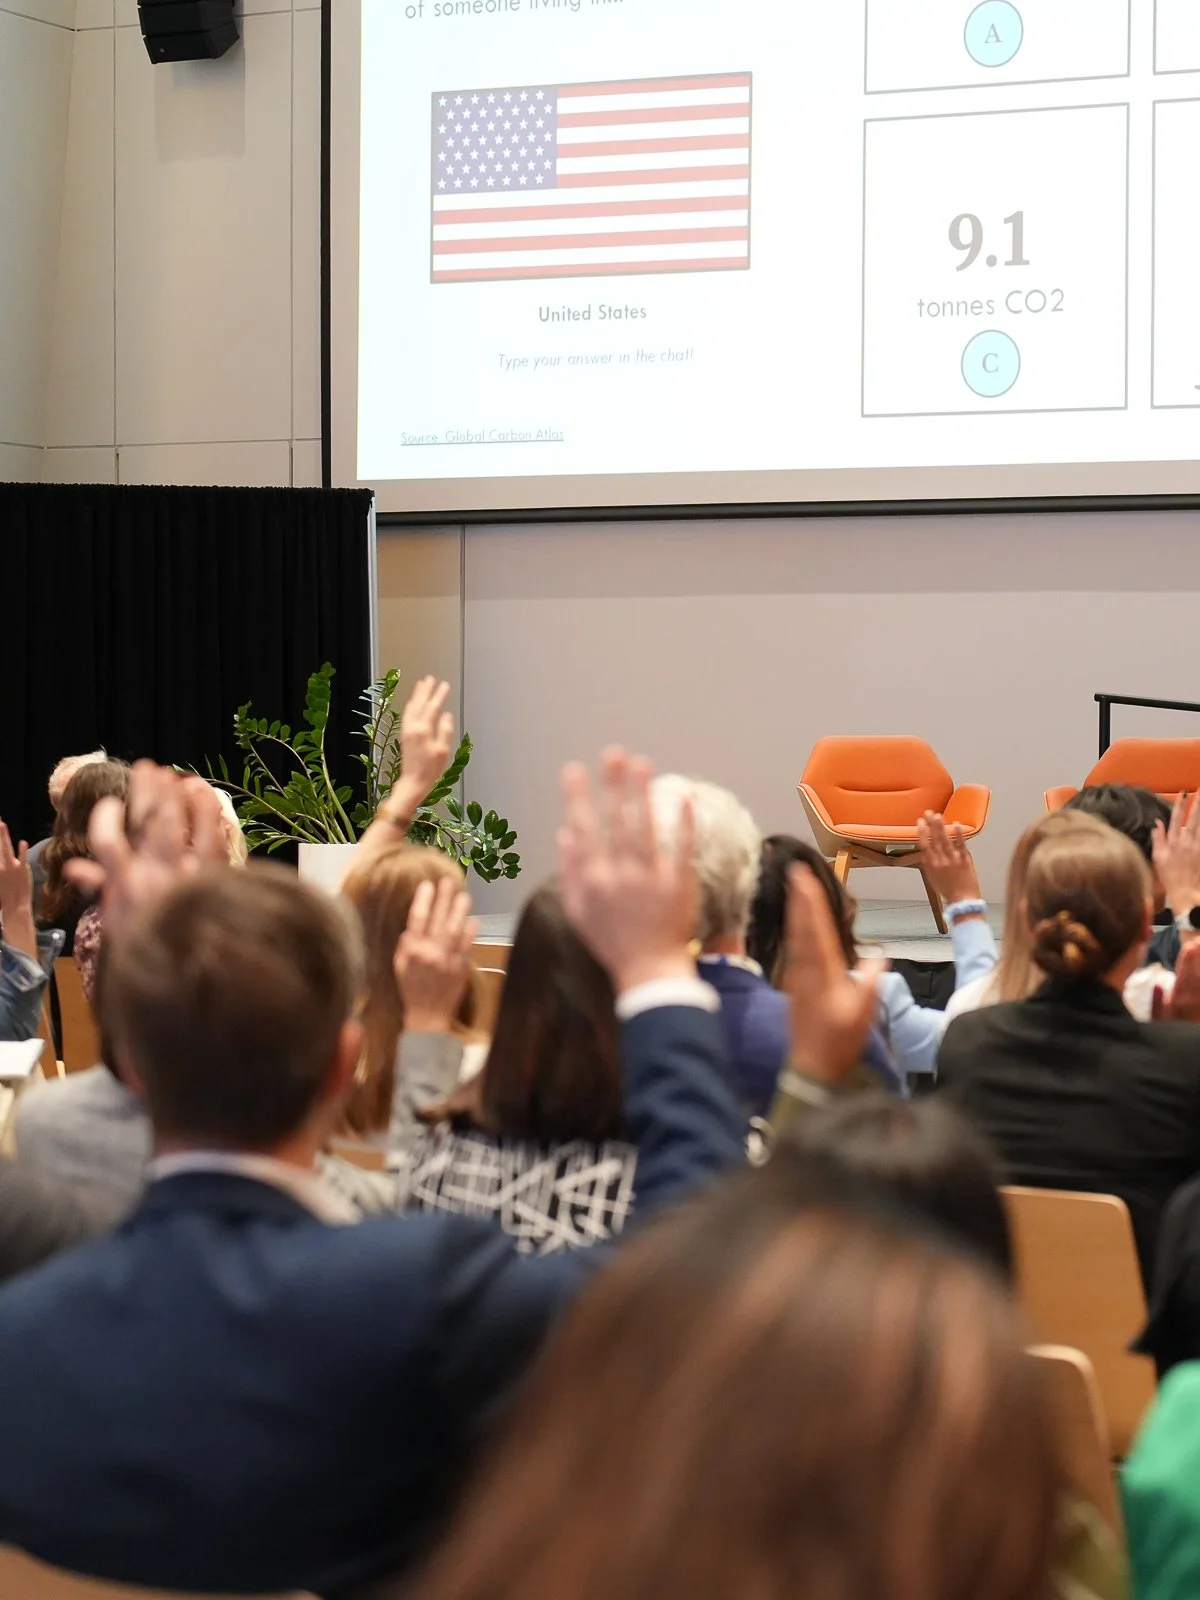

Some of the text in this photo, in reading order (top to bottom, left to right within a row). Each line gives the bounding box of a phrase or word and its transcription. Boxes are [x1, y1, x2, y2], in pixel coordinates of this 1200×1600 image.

[404, 0, 425, 19] of
[434, 0, 521, 17] someone
[984, 23, 1004, 43] A
[948, 211, 1030, 271] 9.1
[539, 304, 647, 322] United States
[917, 288, 1065, 318] tonnes CO2
[498, 347, 695, 371] Type your answer in the chat!
[982, 353, 999, 373] C
[445, 429, 485, 443] Global
[489, 428, 531, 442] Carbon
[536, 426, 564, 441] Atlas
